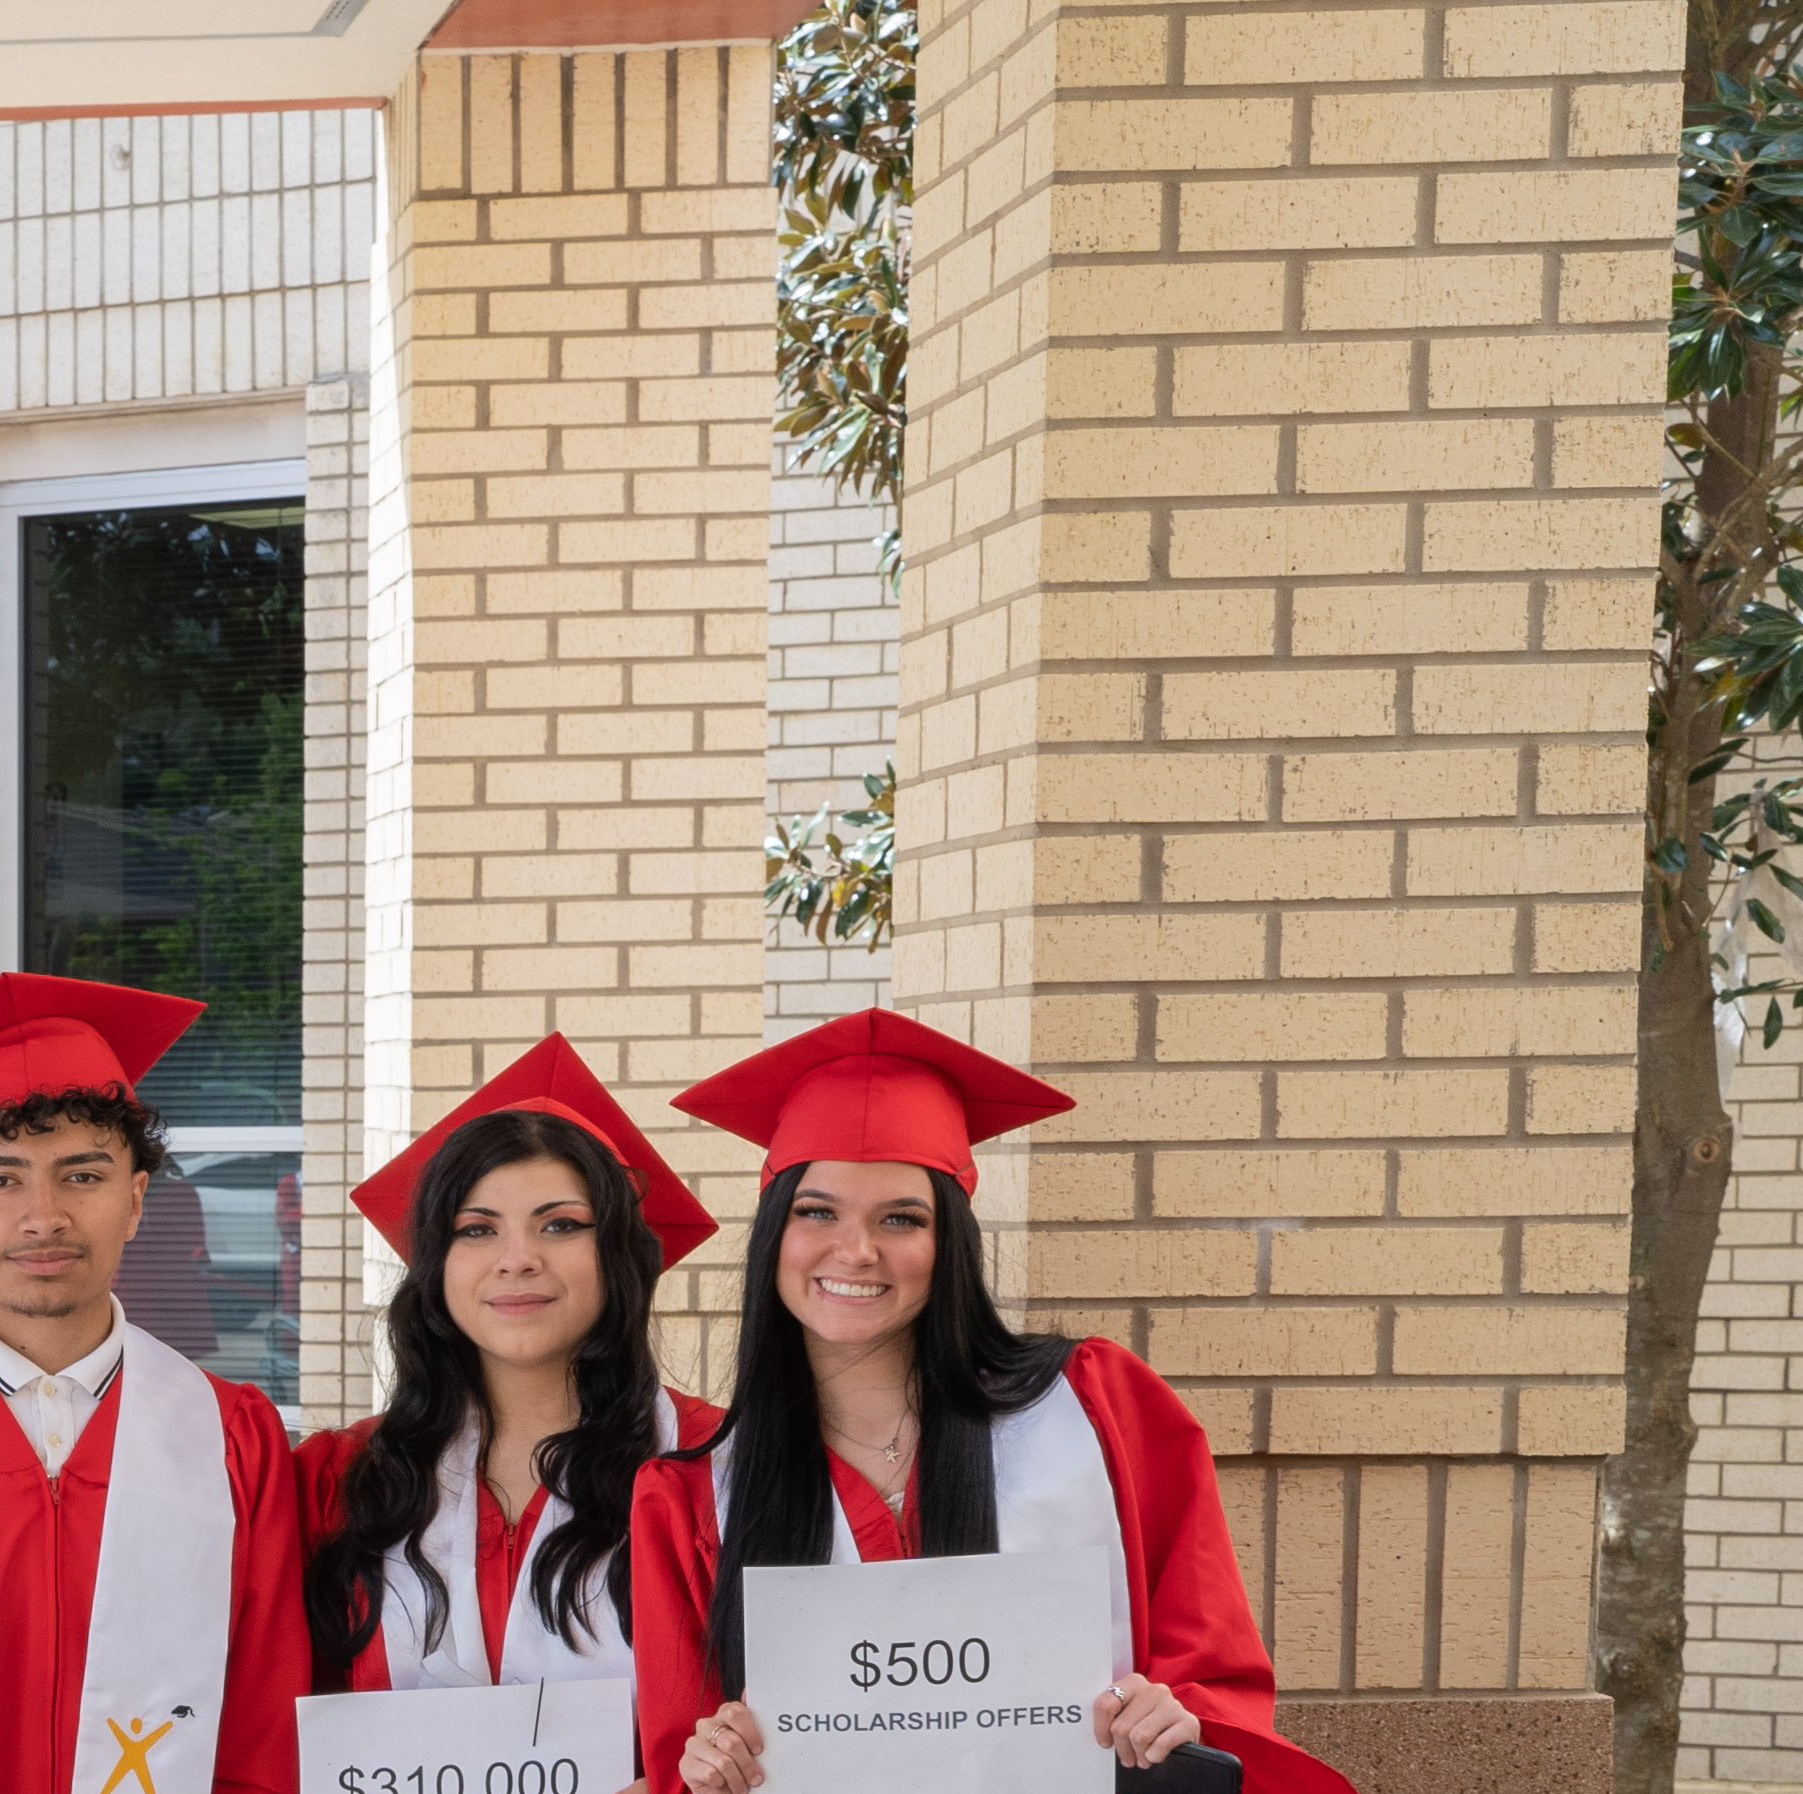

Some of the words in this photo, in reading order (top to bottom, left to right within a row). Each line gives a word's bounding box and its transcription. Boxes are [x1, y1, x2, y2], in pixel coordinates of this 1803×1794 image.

[849, 1637, 990, 1693] $500
[777, 1710, 968, 1733] SCHOLARSHIP
[976, 1704, 1082, 1729] OFFERS
